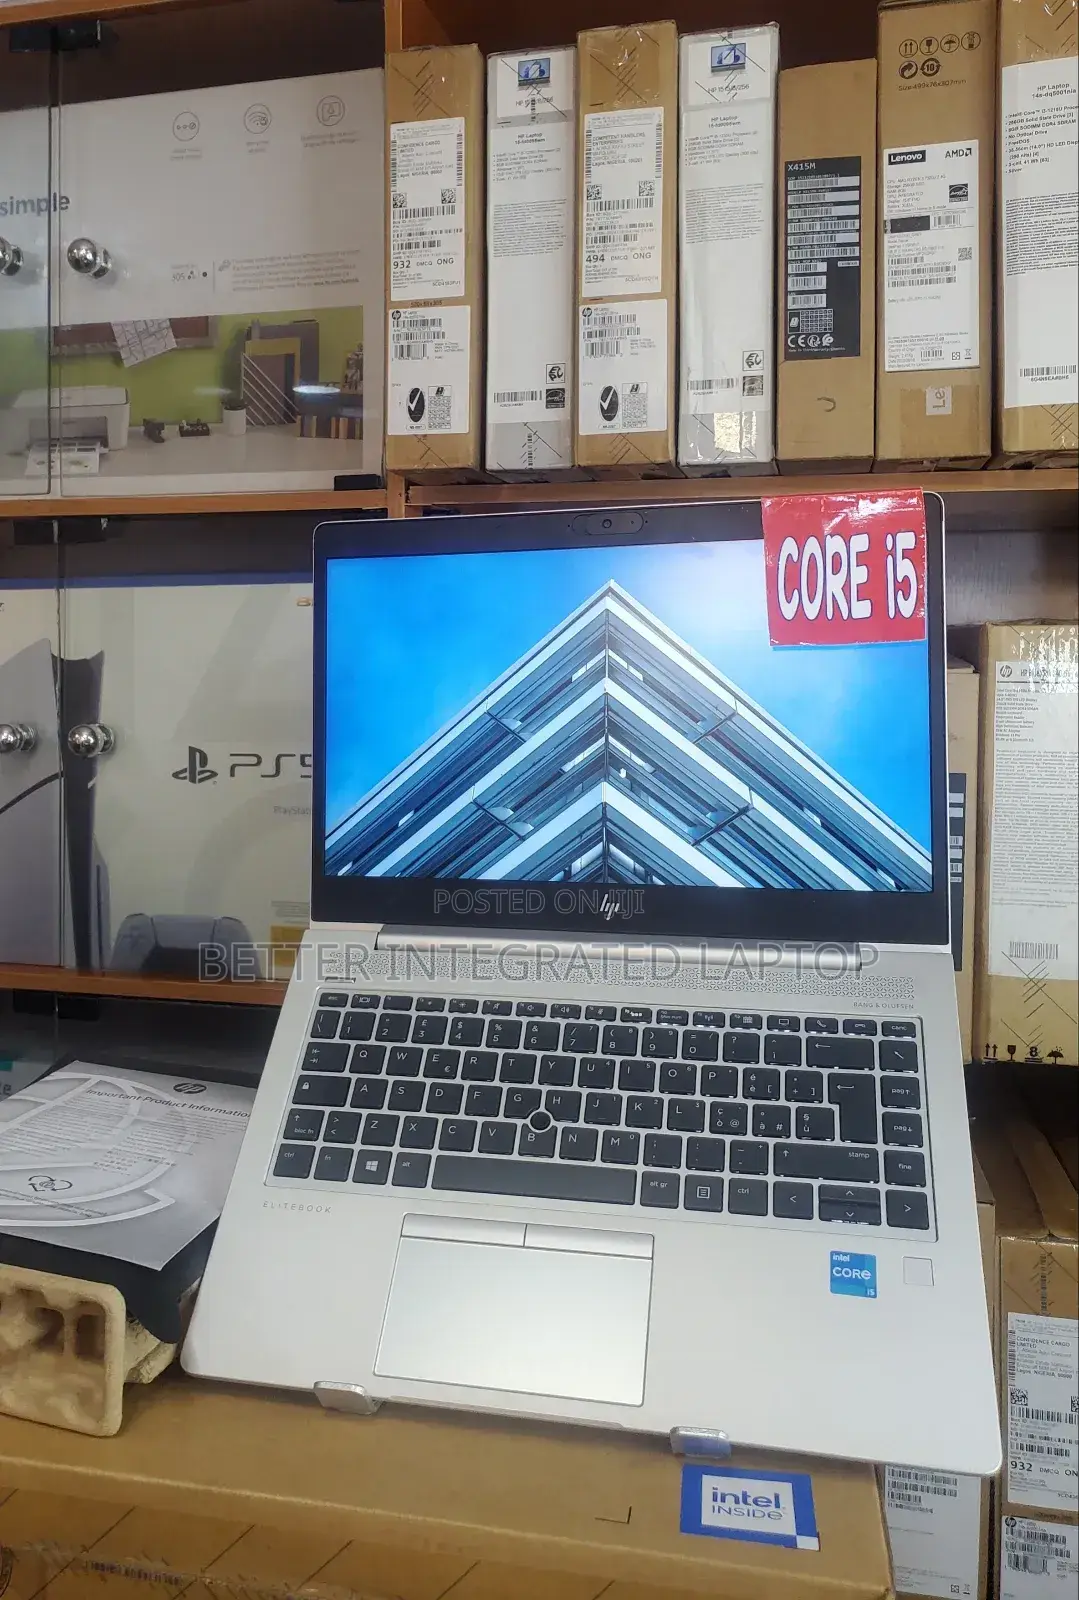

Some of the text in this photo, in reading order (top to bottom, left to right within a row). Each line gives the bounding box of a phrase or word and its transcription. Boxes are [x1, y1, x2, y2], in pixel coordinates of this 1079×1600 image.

[926, 64, 934, 72] 10
[945, 149, 964, 158] AMD
[891, 154, 922, 162] Lenovo
[788, 162, 816, 171] X415M
[0, 192, 70, 216] simple
[586, 254, 605, 263] 494
[633, 252, 651, 260] ONG
[393, 260, 411, 269] 932
[777, 531, 918, 621] CORE i5
[360, 1050, 367, 1058] Q
[397, 1052, 407, 1060] W
[548, 1061, 555, 1069] Y
[587, 1064, 594, 1072] U
[709, 1072, 716, 1080] P
[398, 1086, 405, 1094] S
[86, 1088, 142, 1102] Important
[143, 1095, 188, 1110] Product
[514, 1094, 522, 1102] G
[553, 1096, 561, 1104] H
[593, 1099, 599, 1107] J
[676, 1106, 682, 1114] L
[371, 1120, 378, 1128] Z
[409, 1123, 417, 1131] X
[489, 1128, 496, 1136] V
[611, 1138, 620, 1146] M
[262, 1201, 332, 1214] ELITEBOOK
[832, 1253, 850, 1262] intel
[1010, 1460, 1032, 1472] 932
[712, 1487, 781, 1509] intel
